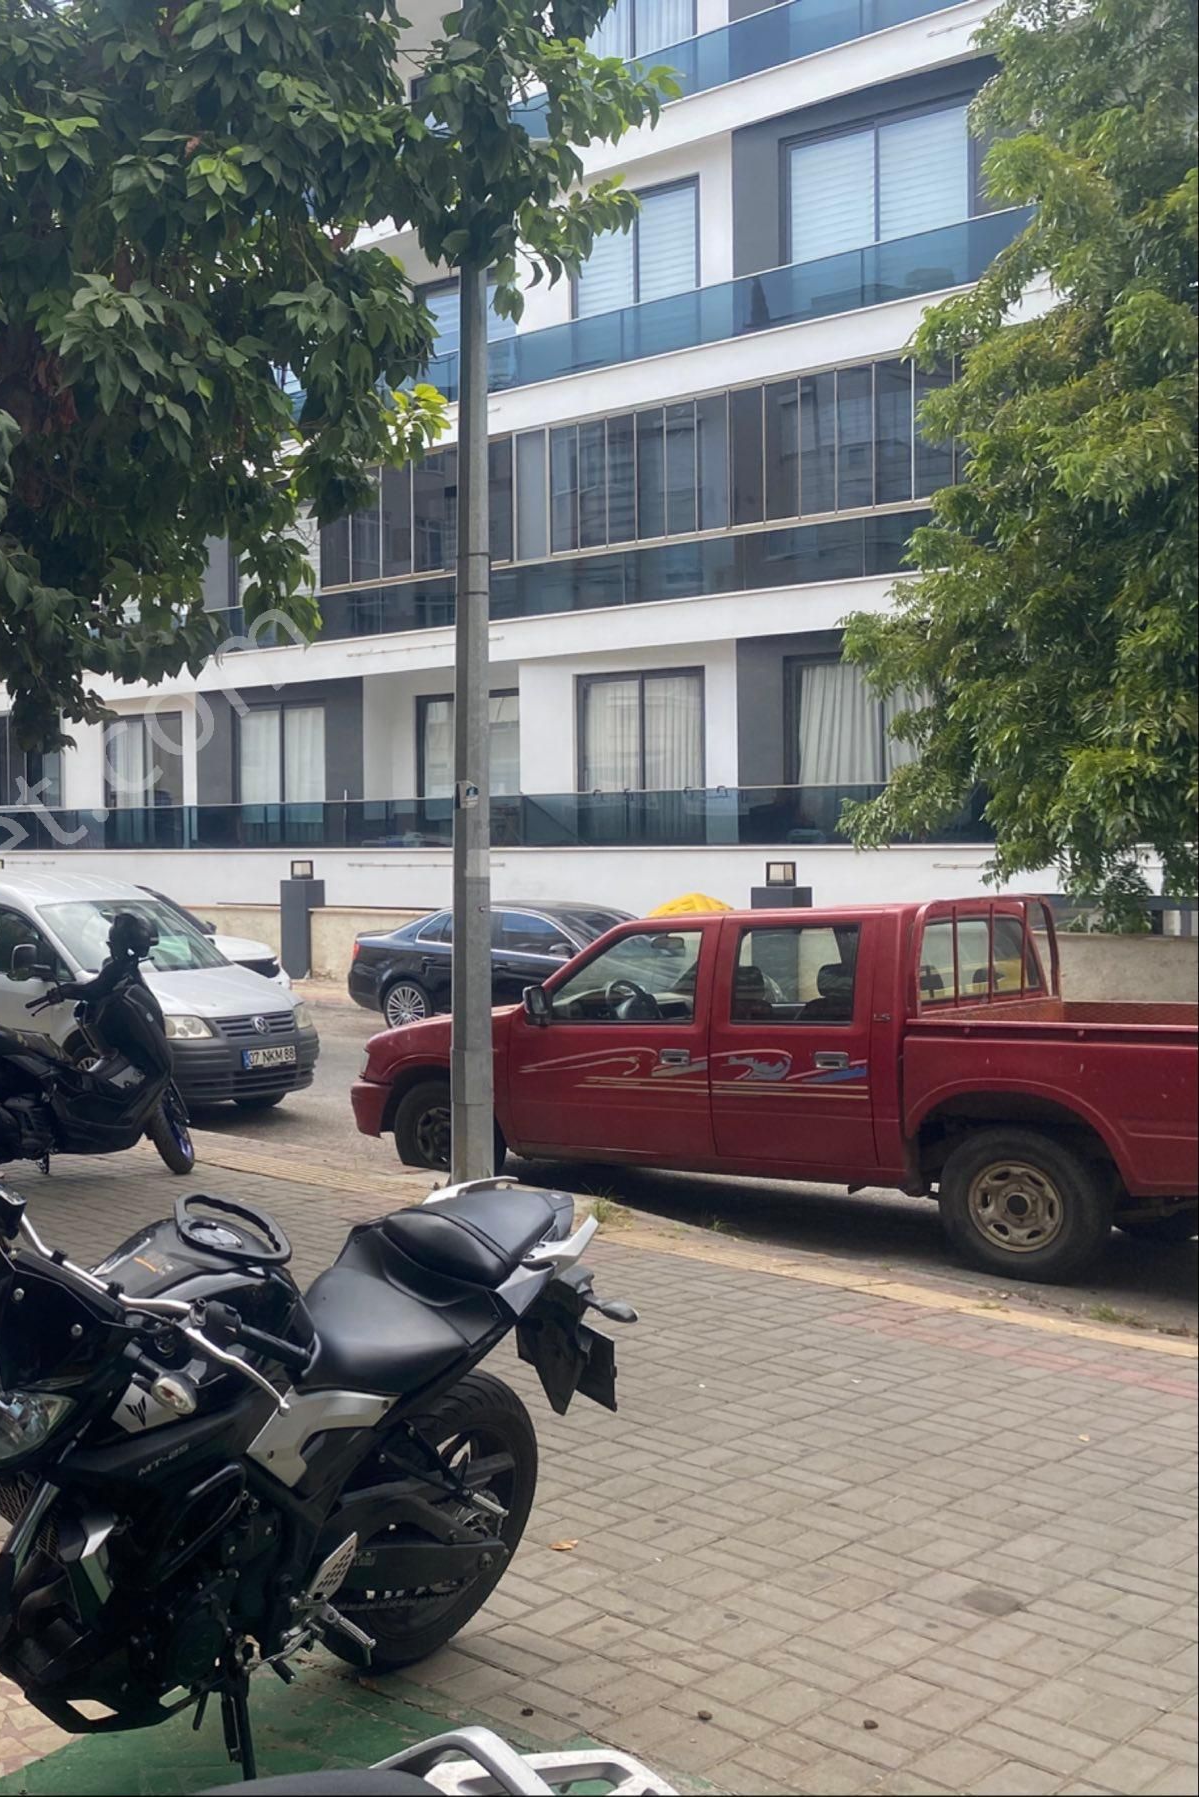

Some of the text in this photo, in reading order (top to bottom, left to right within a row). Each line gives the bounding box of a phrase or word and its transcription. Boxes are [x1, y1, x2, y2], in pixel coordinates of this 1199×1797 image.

[249, 1051, 259, 1065] 07
[262, 1048, 283, 1063] NKM
[137, 1442, 190, 1477] MT-25
